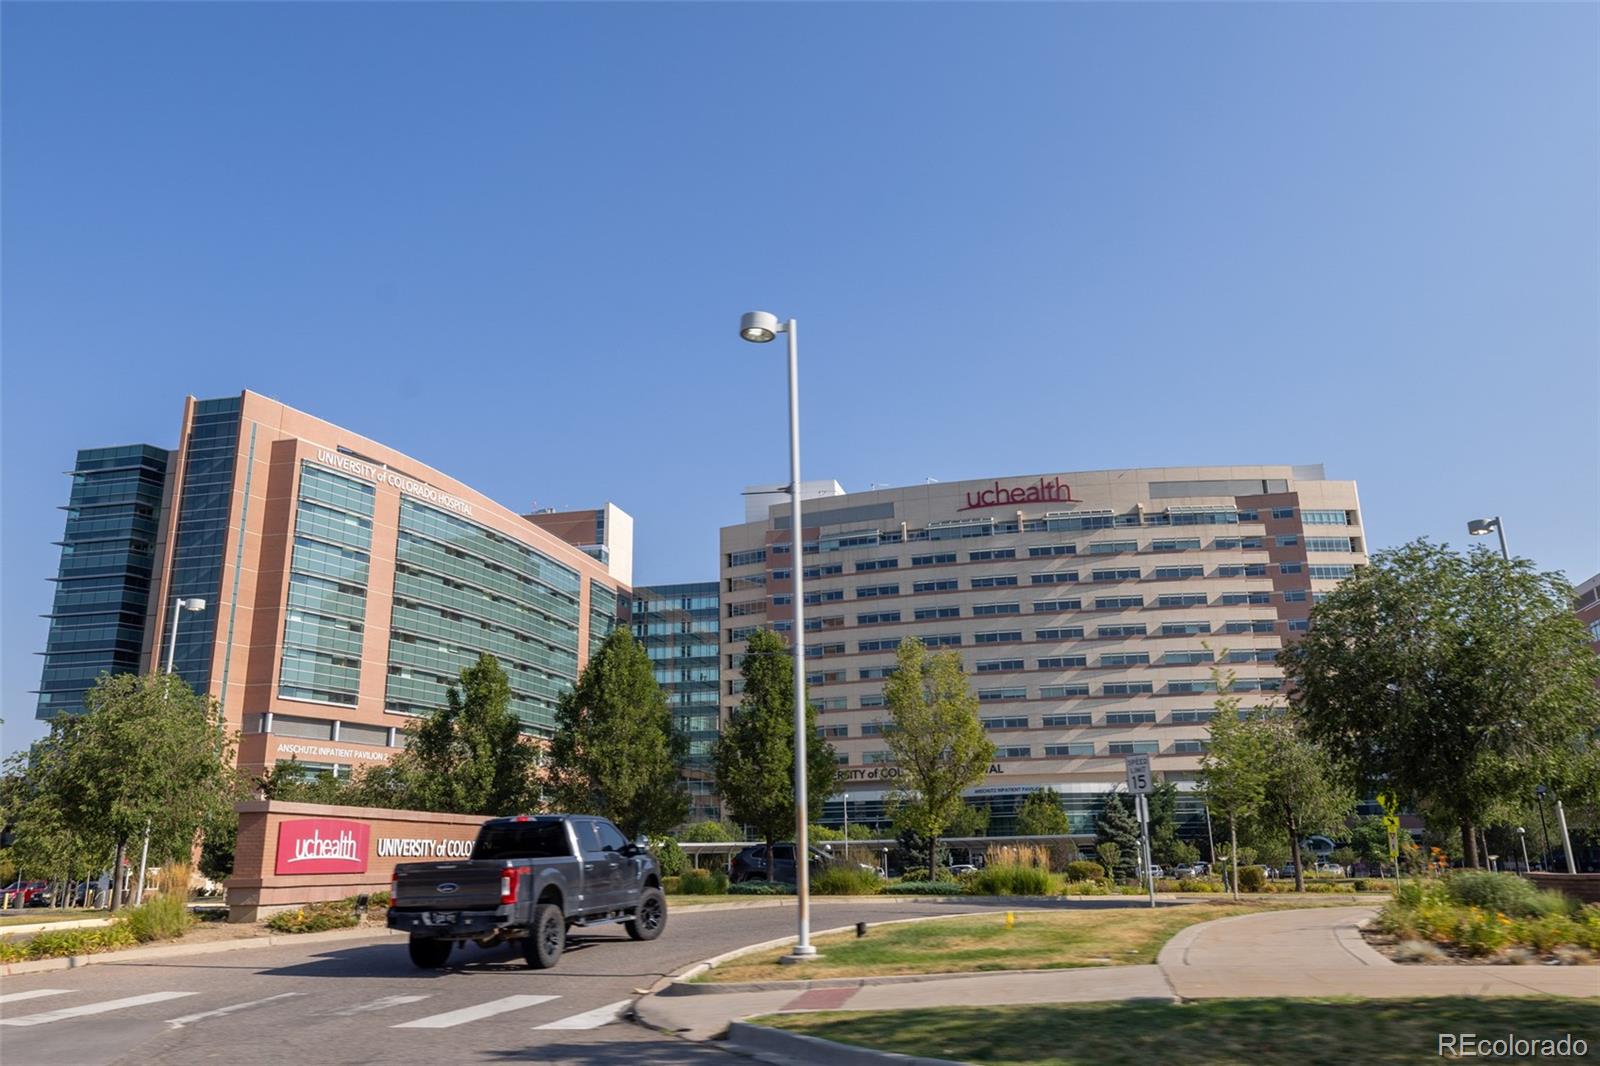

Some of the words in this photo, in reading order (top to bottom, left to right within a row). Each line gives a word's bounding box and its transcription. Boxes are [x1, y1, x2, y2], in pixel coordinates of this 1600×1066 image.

[317, 449, 377, 479] UNIVERSITY
[377, 471, 388, 483] of
[388, 473, 438, 501] COLORADO
[438, 492, 473, 516] HOSPITAL
[967, 476, 1072, 508] uchealth
[277, 744, 318, 755] ANSCHUTZ
[318, 747, 353, 758] INPATIENT
[354, 750, 384, 761] PAVILION
[867, 768, 878, 779] of
[1132, 774, 1146, 789] 15
[295, 829, 357, 859] uchealth
[377, 838, 436, 857] UNIVERSITY
[436, 839, 447, 857] of
